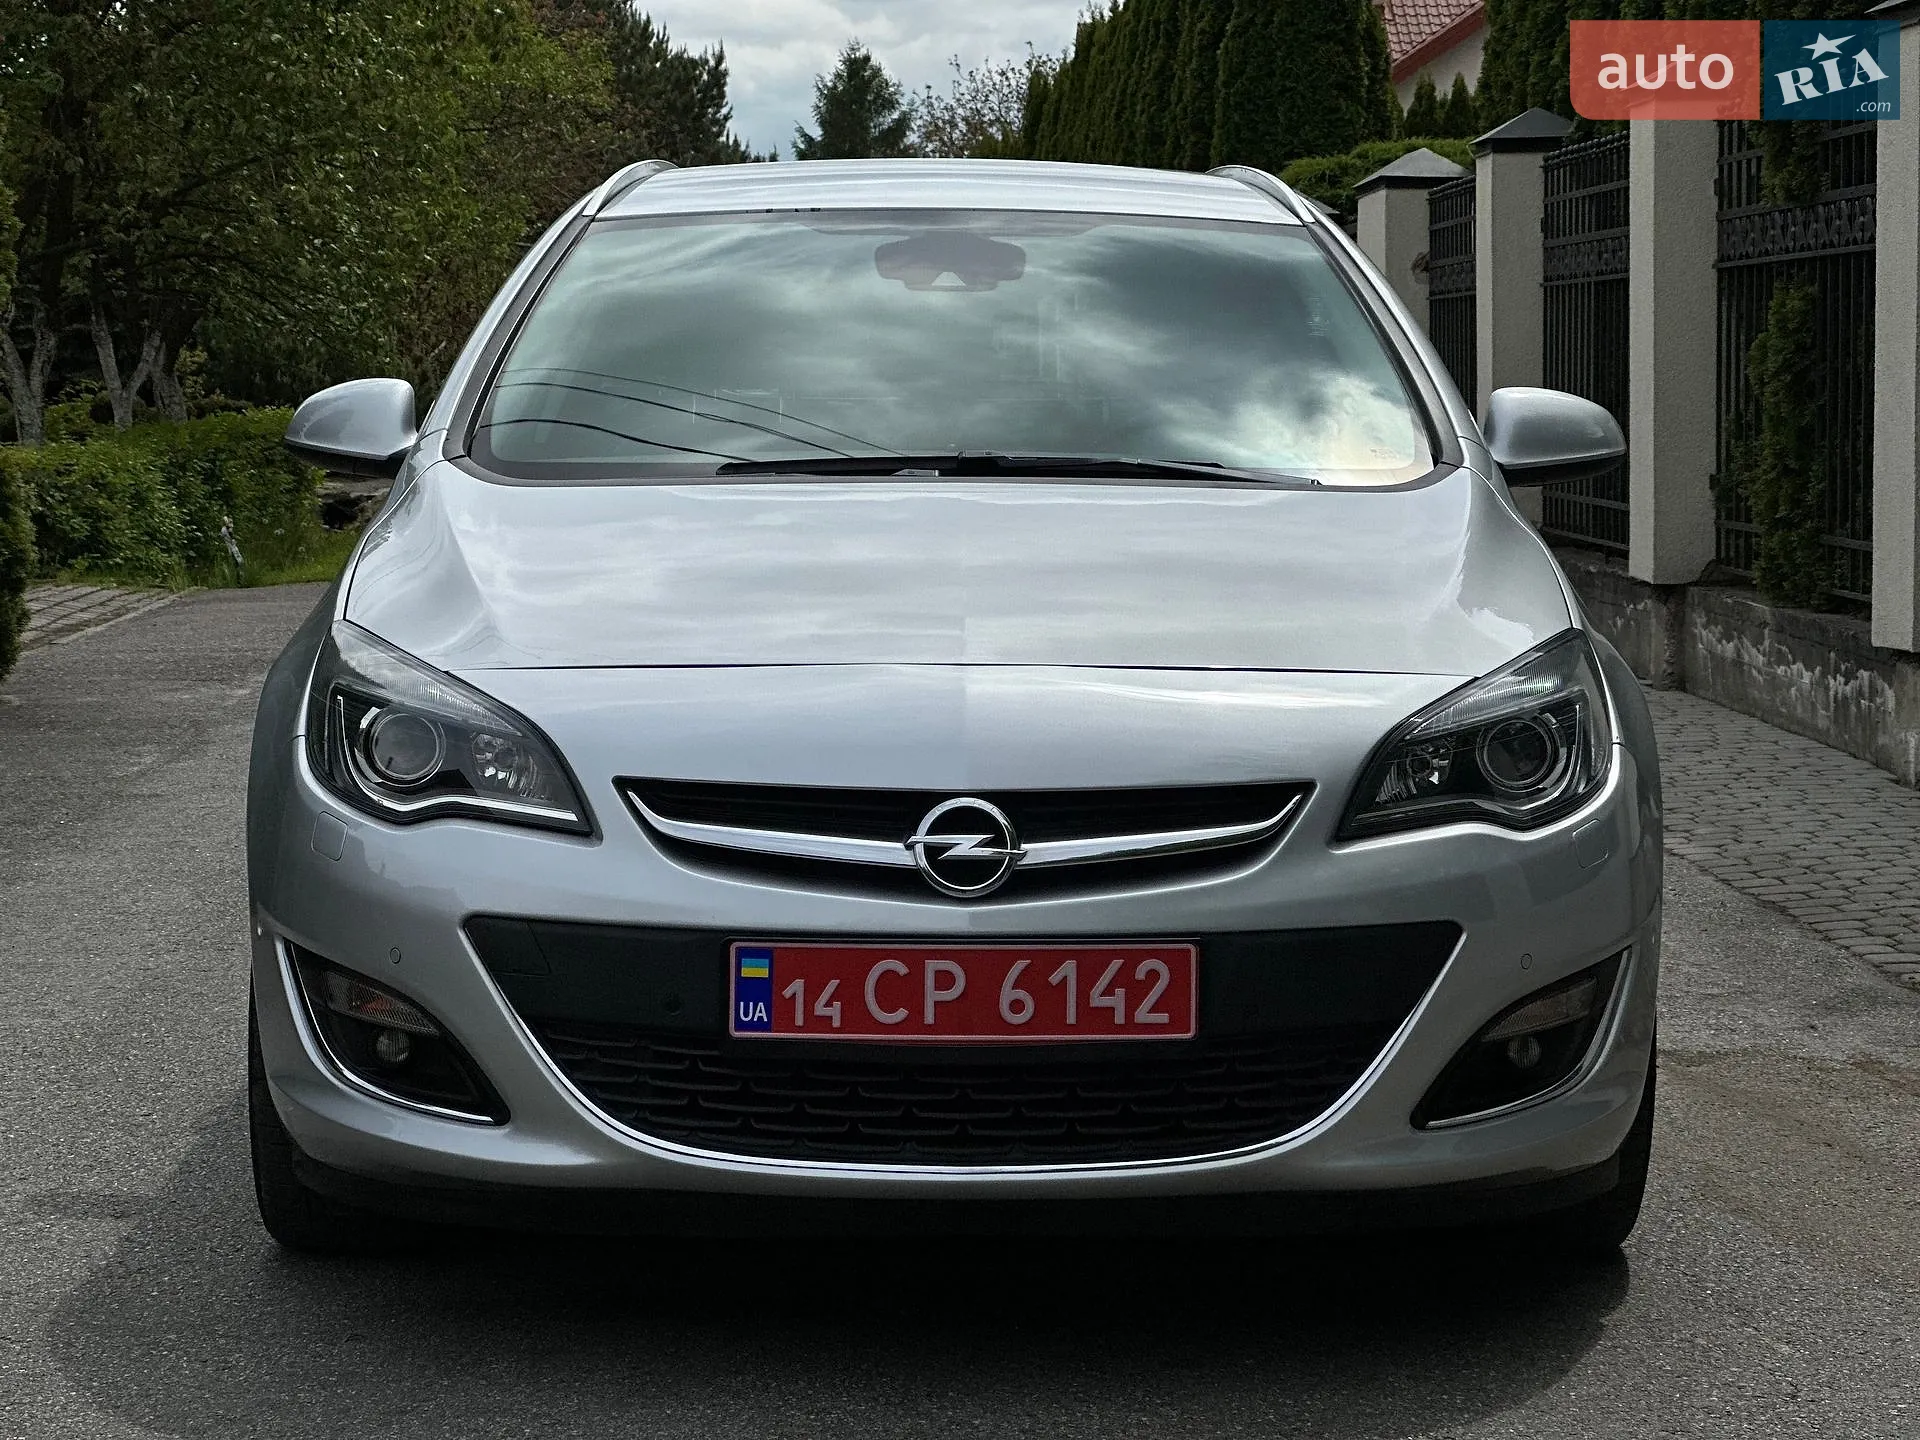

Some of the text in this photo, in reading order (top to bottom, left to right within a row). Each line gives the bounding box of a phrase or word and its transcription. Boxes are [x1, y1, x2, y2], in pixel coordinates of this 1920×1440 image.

[738, 1001, 769, 1023] UA
[781, 958, 1172, 1028] 14 CP 6142
